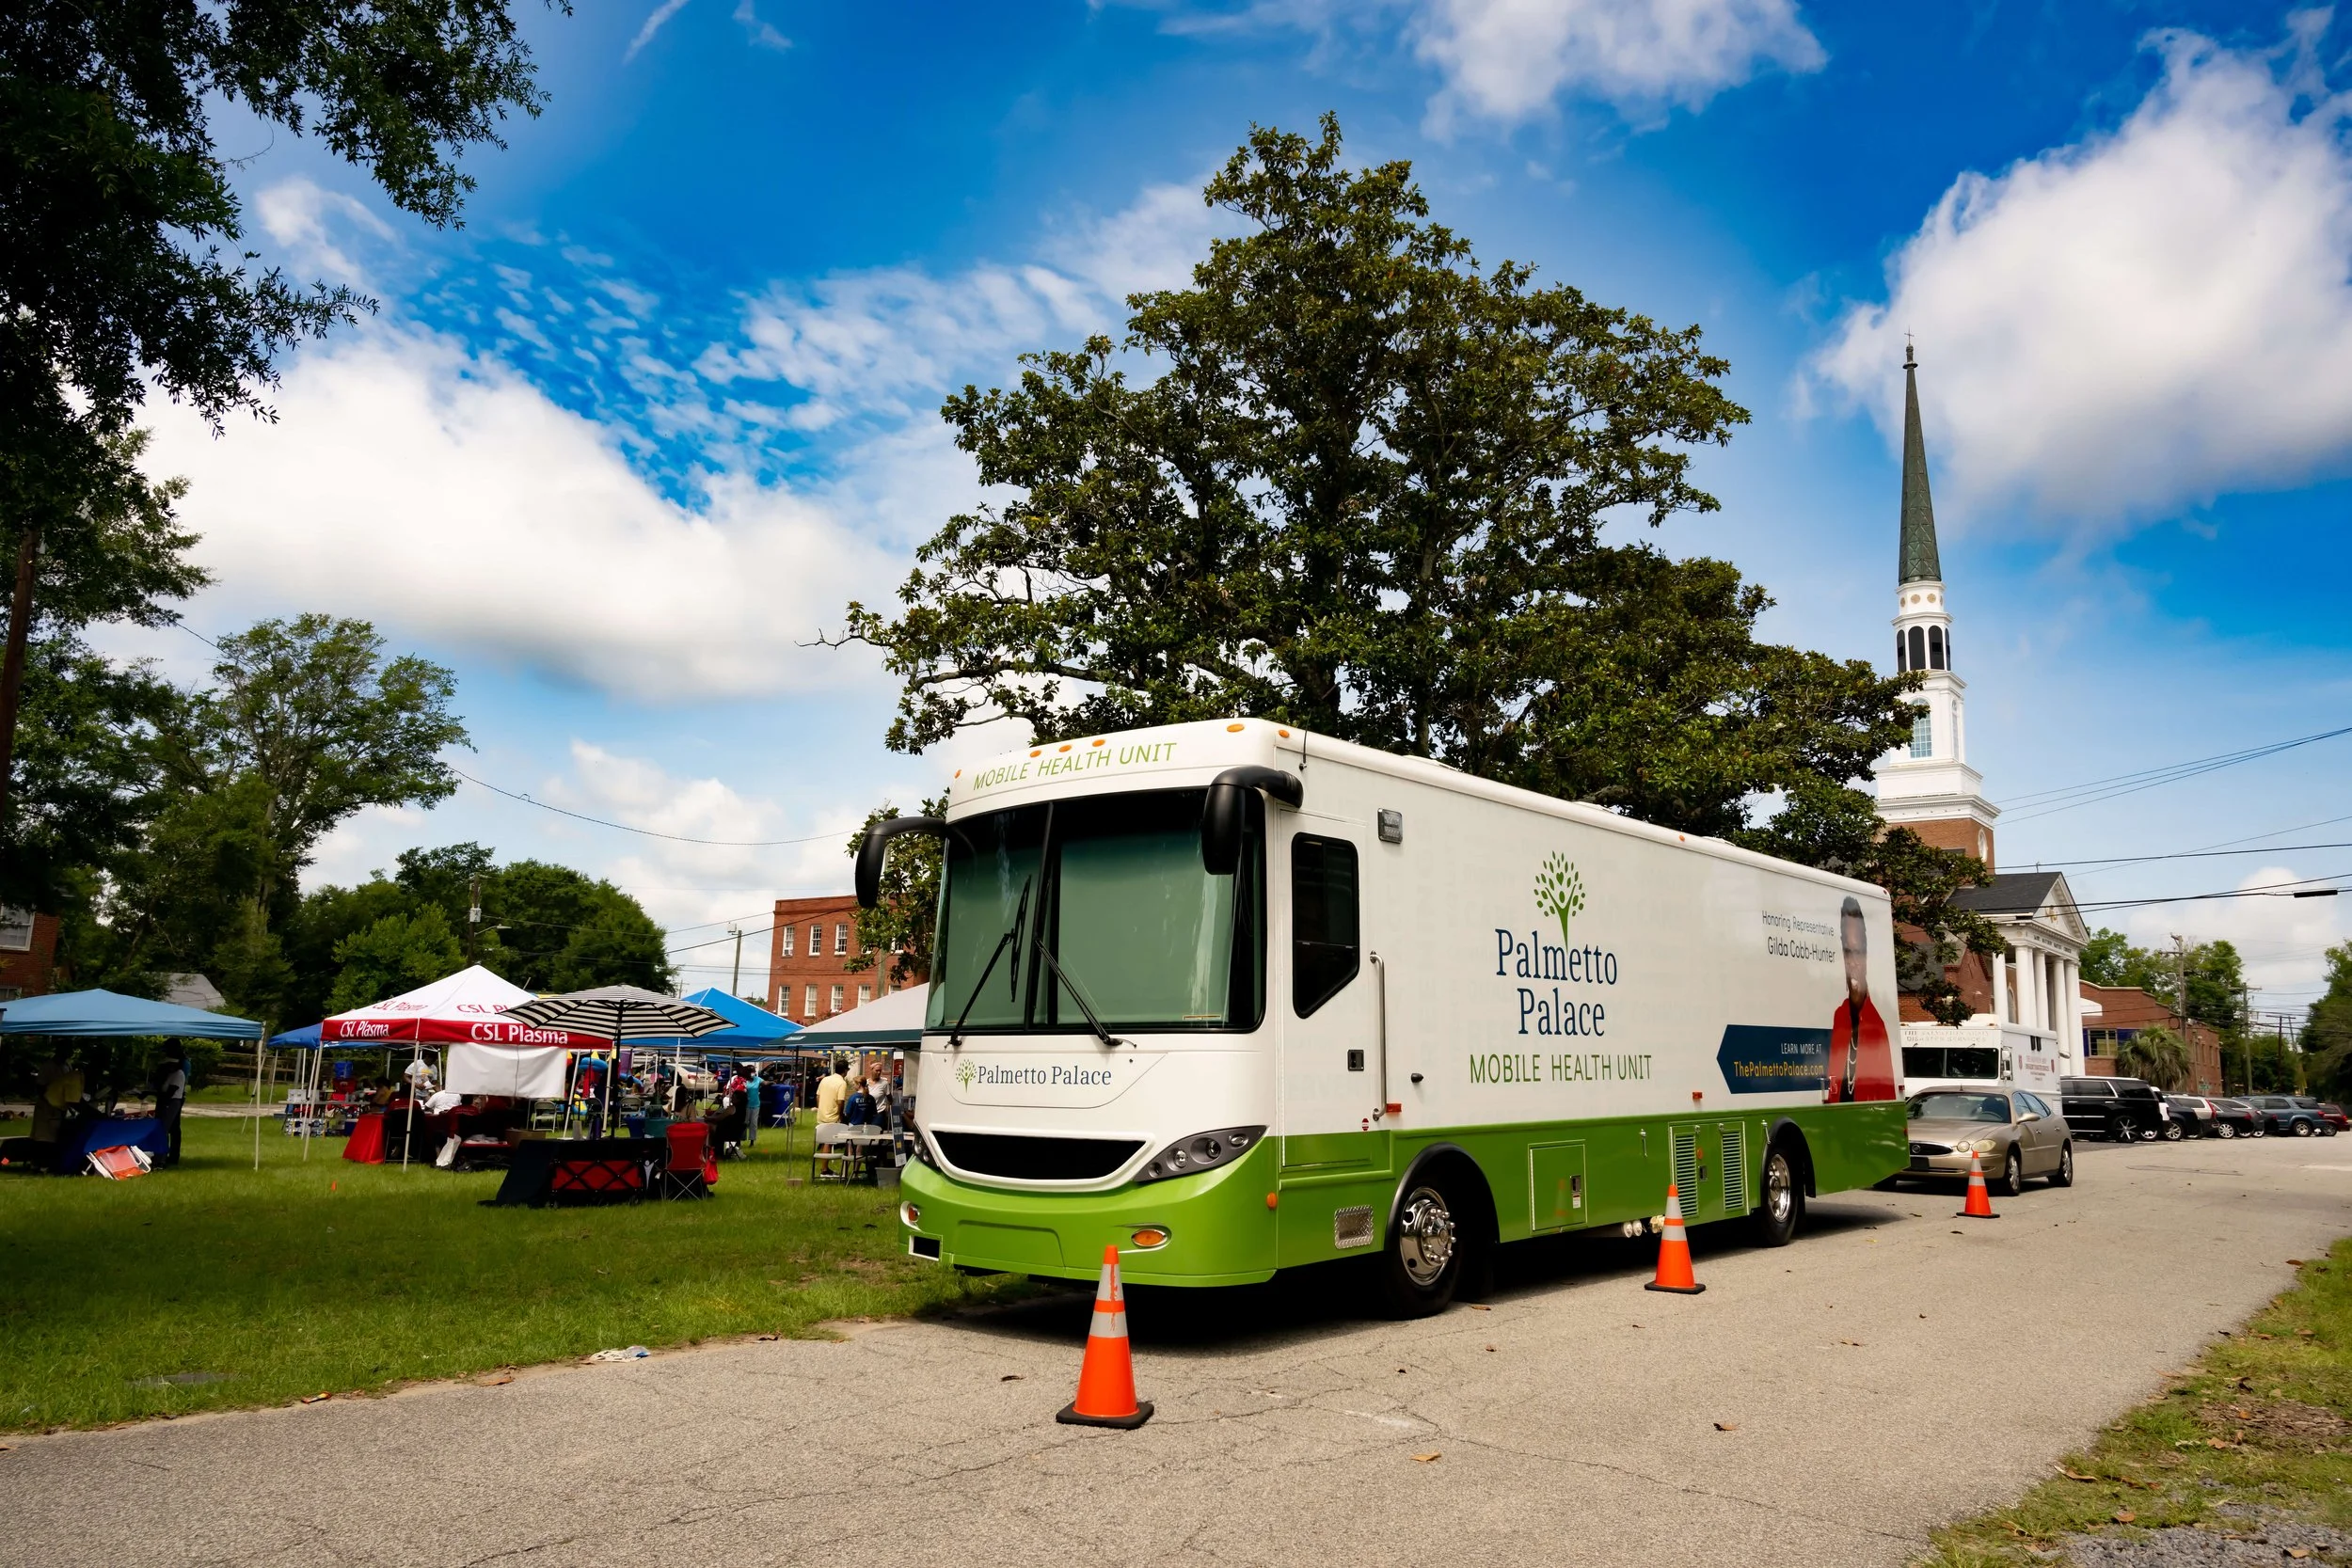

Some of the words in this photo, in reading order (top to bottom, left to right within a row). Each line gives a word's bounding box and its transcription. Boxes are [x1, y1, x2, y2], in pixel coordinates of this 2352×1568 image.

[974, 762, 1030, 790] MOBILE
[1038, 749, 1112, 777] HEALTH
[1119, 742, 1177, 765] UNIT
[1762, 911, 1790, 932] Honoring
[1792, 916, 1835, 937] Representative
[1495, 928, 1617, 985] Palmetto
[1768, 936, 1788, 957] Gilda
[1789, 940, 1836, 963] Cobb-Hunter
[373, 1001, 396, 1010] CSL
[456, 1004, 491, 1013] CSL
[1517, 988, 1605, 1037] Palace
[341, 1022, 356, 1037] CSL
[357, 1021, 389, 1037] Plasma
[470, 1023, 503, 1041] CSL
[508, 1024, 568, 1045] Plasma
[1781, 1042, 1798, 1053] LEARN
[1800, 1043, 1815, 1053] MORE
[1816, 1044, 1821, 1053] AT
[977, 1065, 1047, 1085] Palmetto
[1051, 1065, 1112, 1085] Palace
[1470, 1053, 1541, 1084] MOBILE
[1551, 1053, 1612, 1082] HEALTH
[1617, 1054, 1652, 1081] UNIT
[1734, 1061, 1824, 1077] ThePalmettoPalace.com
